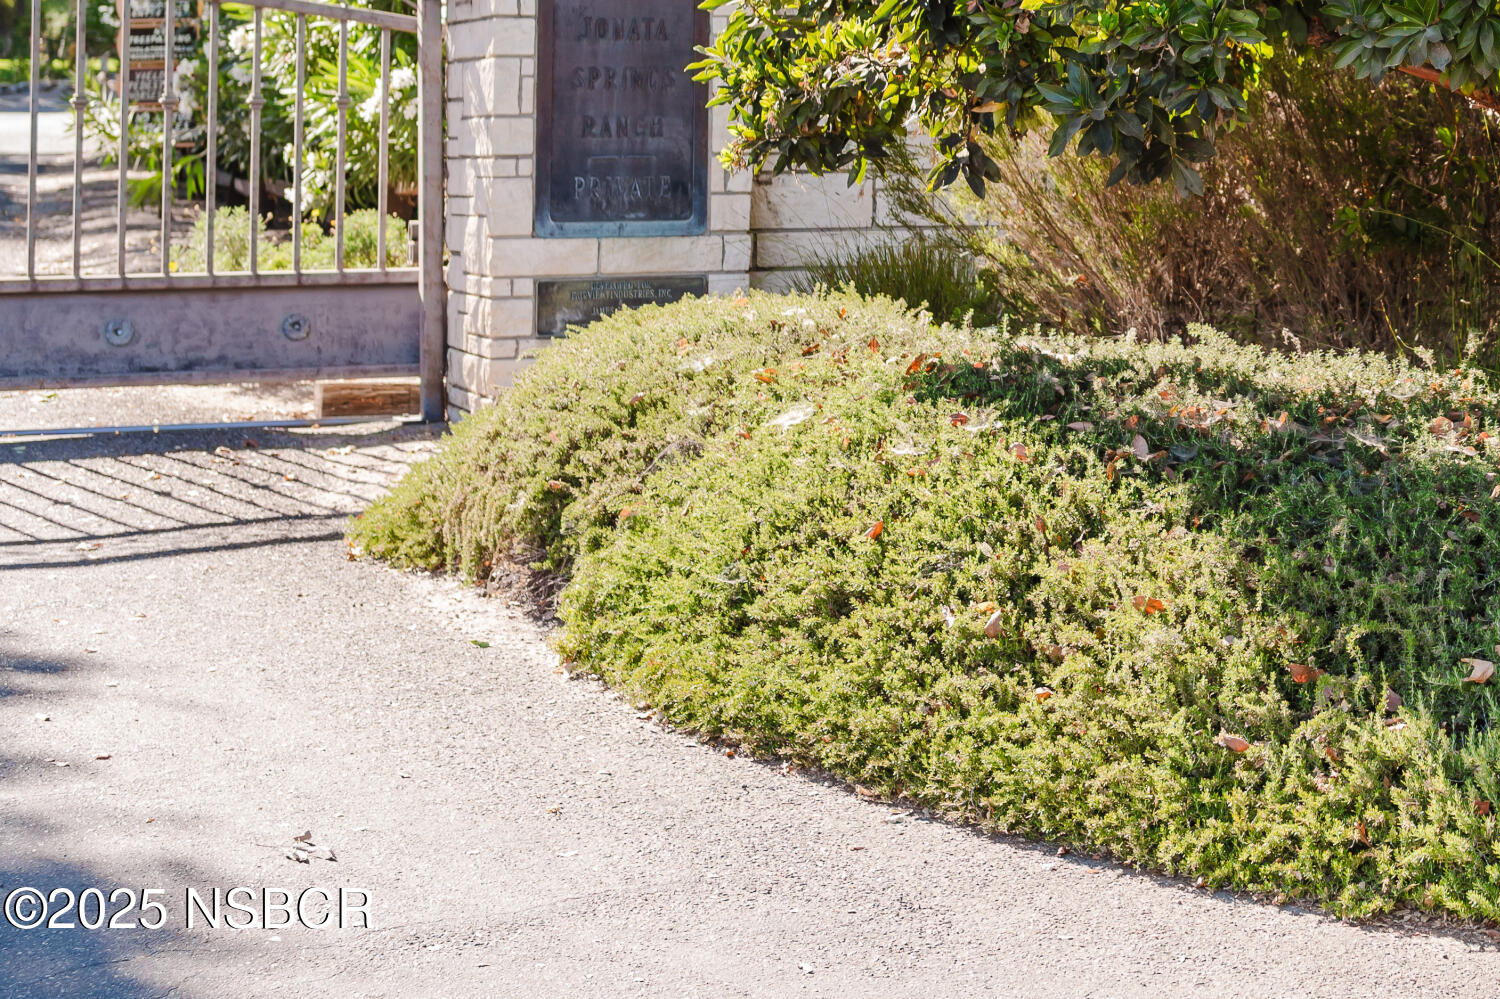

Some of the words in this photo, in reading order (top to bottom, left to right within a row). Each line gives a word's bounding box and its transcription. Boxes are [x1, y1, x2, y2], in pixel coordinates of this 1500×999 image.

[576, 15, 669, 41] JONATA
[571, 65, 677, 91] SPRINGS
[581, 114, 665, 138] RANCH
[573, 175, 672, 201] PRIVATE
